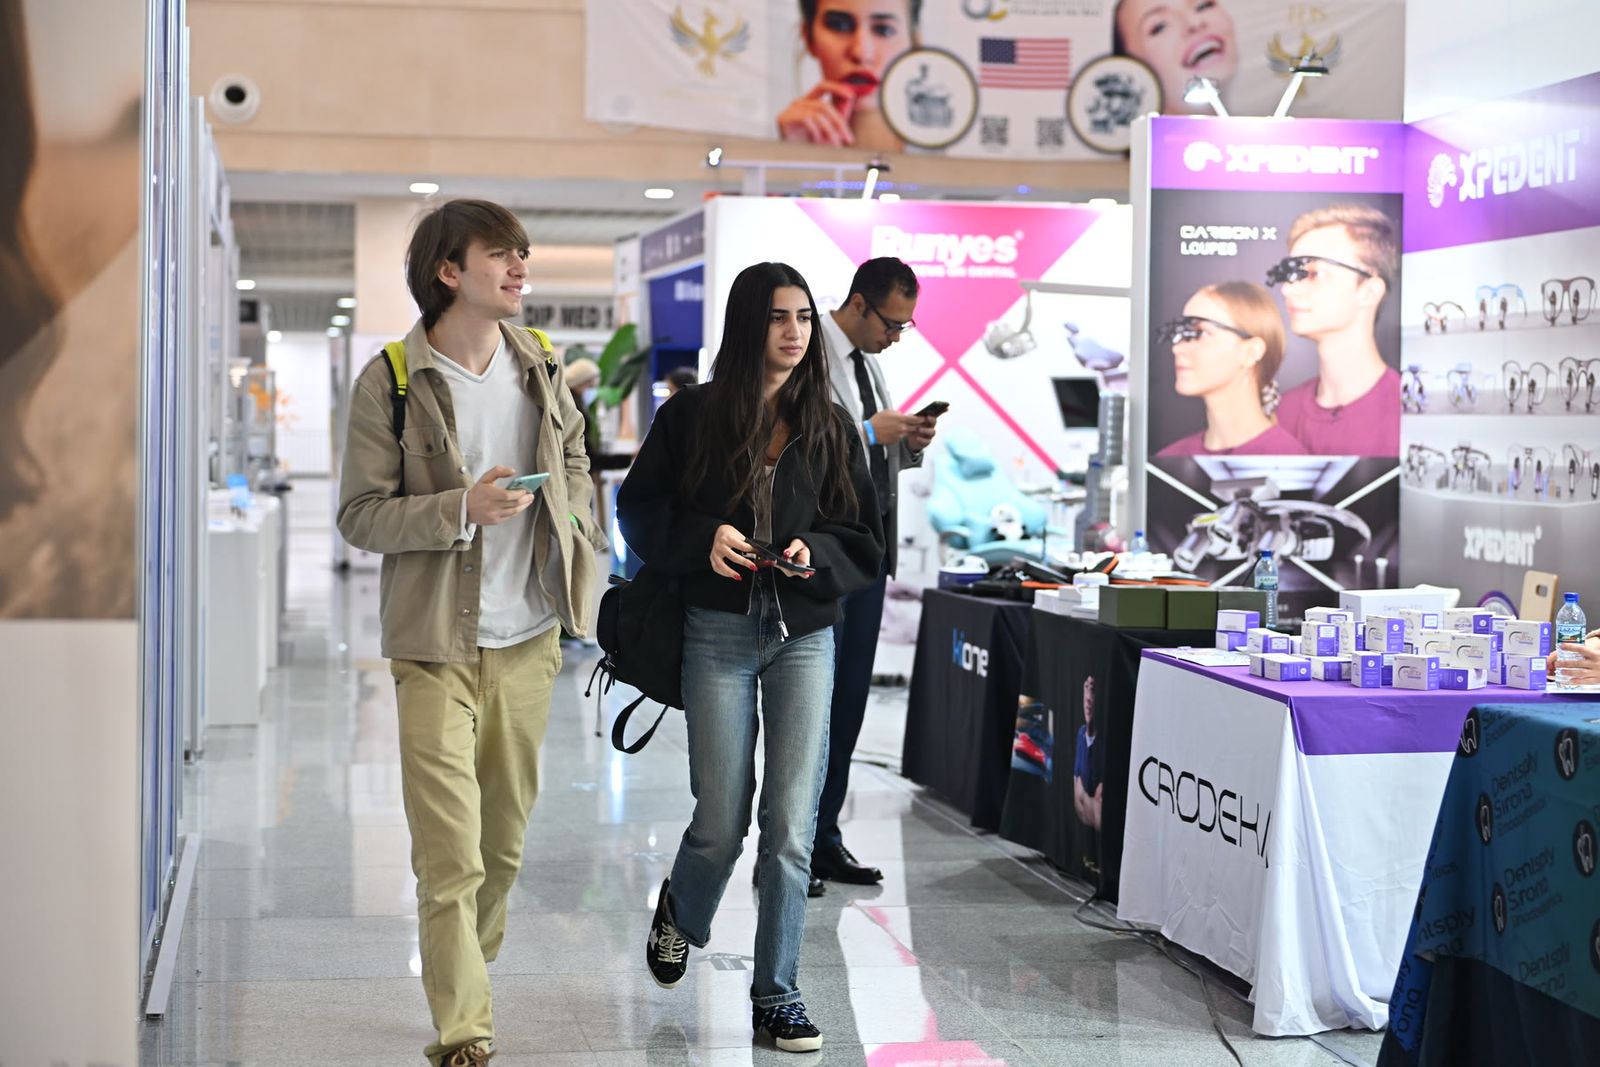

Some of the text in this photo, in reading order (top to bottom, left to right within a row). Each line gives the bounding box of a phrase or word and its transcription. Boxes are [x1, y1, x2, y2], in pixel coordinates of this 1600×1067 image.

[1225, 144, 1370, 174] XPEDENT
[1458, 128, 1580, 202] XPEDENT
[871, 225, 1018, 267] Runyes
[1262, 227, 1277, 240] X
